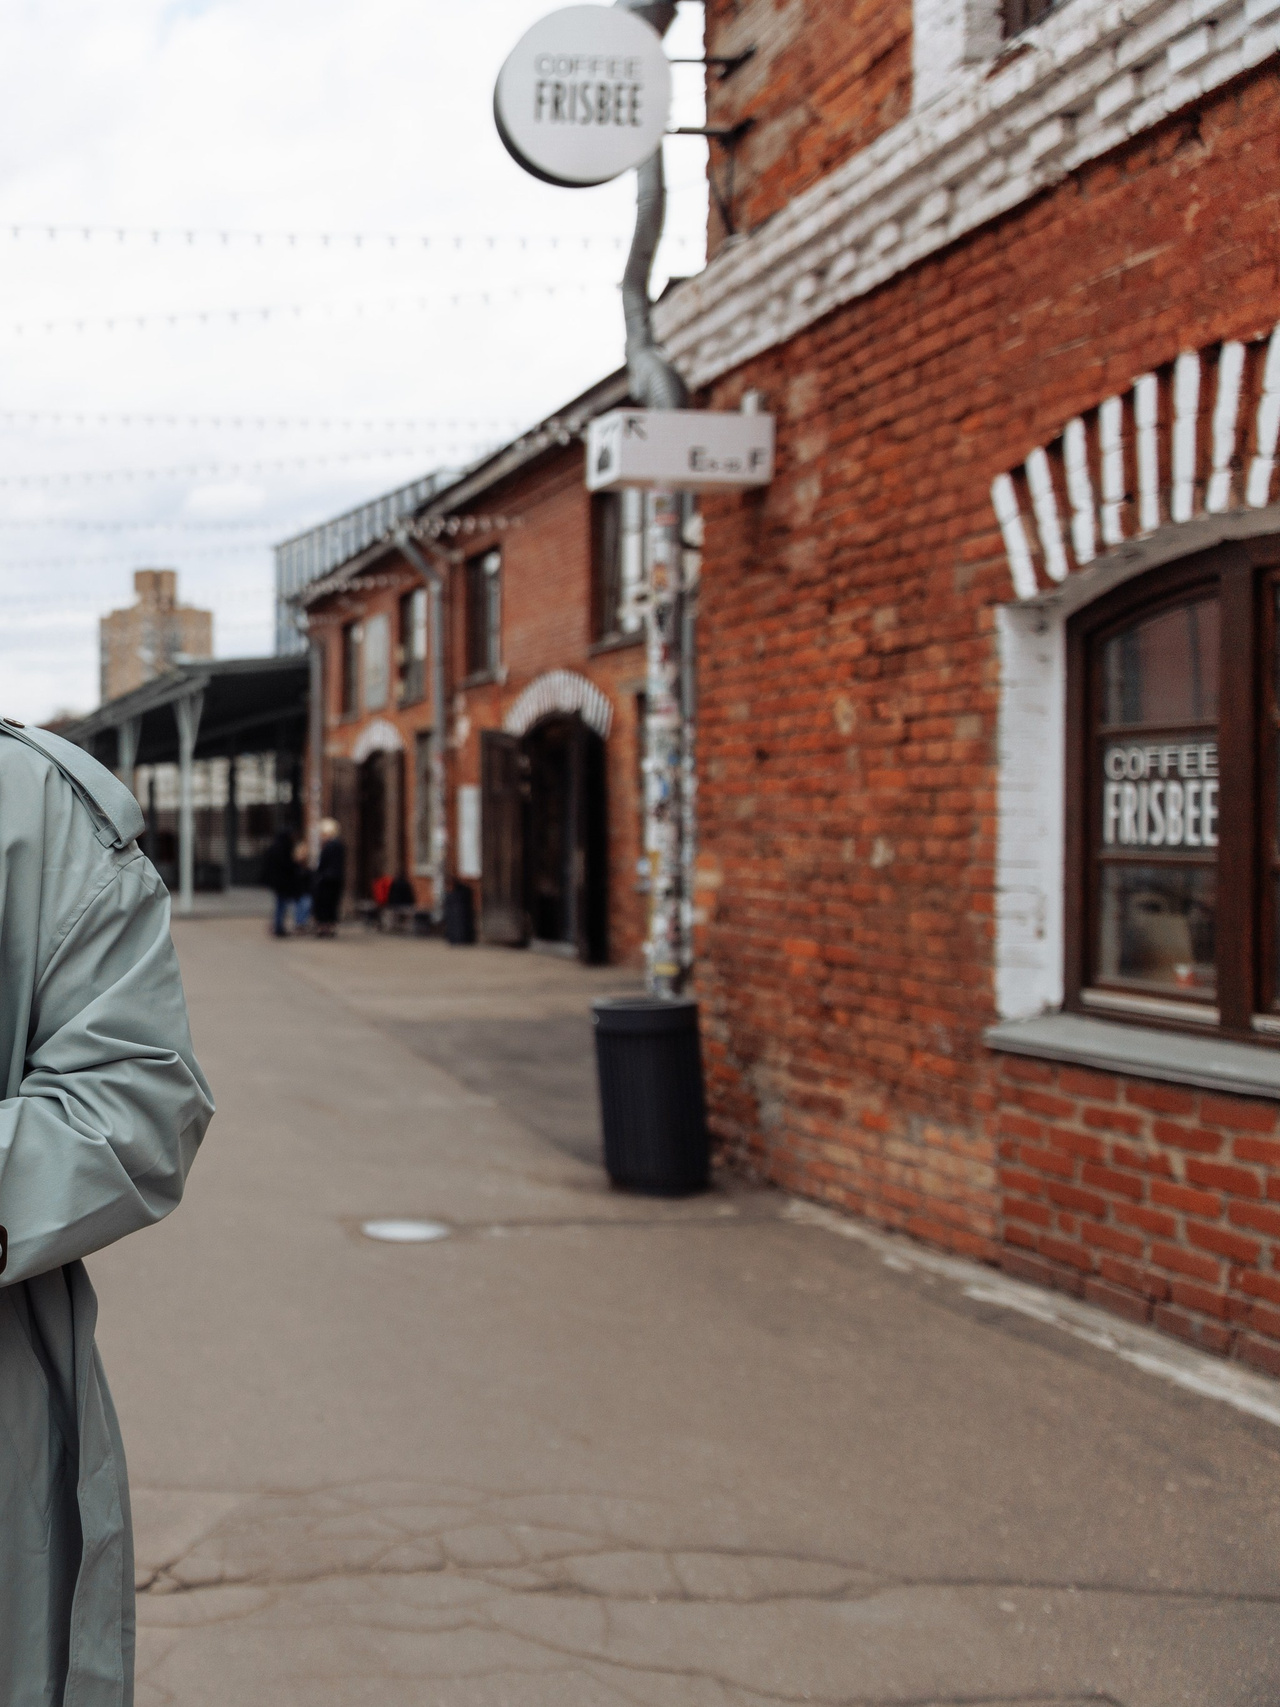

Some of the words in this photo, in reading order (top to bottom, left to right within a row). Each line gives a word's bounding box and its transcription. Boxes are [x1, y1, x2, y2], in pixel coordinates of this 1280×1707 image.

[534, 53, 642, 79] COFFEE
[534, 80, 643, 126] FRISBEE
[1104, 743, 1219, 780] COFFEE
[1103, 779, 1219, 847] FRISBEE
